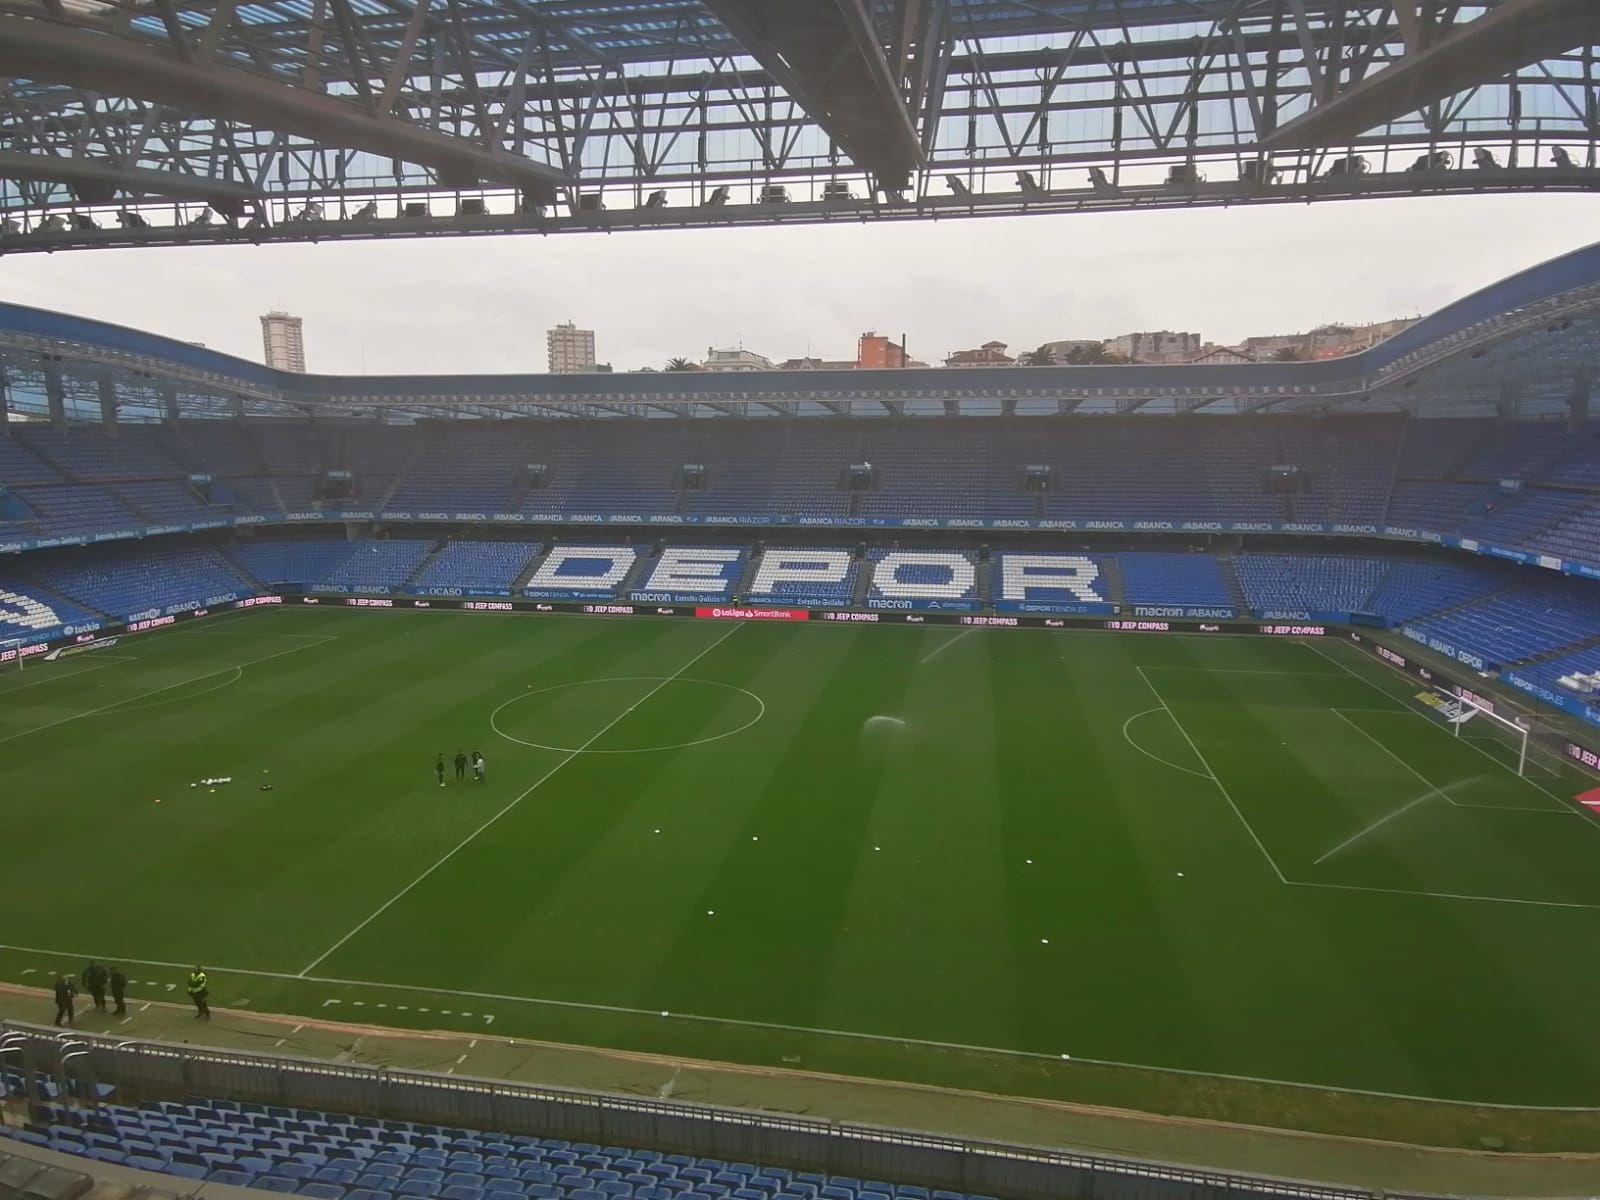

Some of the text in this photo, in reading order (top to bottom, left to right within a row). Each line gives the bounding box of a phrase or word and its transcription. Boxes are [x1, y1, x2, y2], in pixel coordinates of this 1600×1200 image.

[418, 512, 448, 520] ABANCA
[493, 513, 524, 521] ABANCA
[532, 514, 564, 522] ABANCA
[705, 516, 738, 524] ABANCA
[739, 516, 770, 524] RIAZOR
[834, 518, 866, 526] RIAZOR
[903, 518, 938, 526] ABANCA
[992, 520, 1030, 528] ABANCA
[1038, 520, 1077, 528] ABANCA
[1085, 520, 1124, 528] ABANCA
[1133, 522, 1173, 530] ABANCA
[1182, 522, 1223, 530] ABANCA
[1232, 522, 1273, 530] ABANCA
[1281, 523, 1323, 532] ABANCA
[1332, 524, 1377, 534] ABANCA
[353, 586, 390, 594] ABANCA
[429, 588, 462, 596] OCASO
[631, 592, 671, 602] macron
[166, 600, 202, 614] ABANCA
[868, 600, 912, 608] macron
[722, 608, 792, 618] LaLiga SmartBank
[1135, 606, 1233, 618] macron ABANCA
[836, 612, 850, 620] JEEP
[851, 612, 879, 622] COMPASS
[1263, 612, 1311, 621] ABANCA
[972, 616, 987, 625] JEEP
[988, 617, 1018, 626] COMPASS
[1121, 621, 1137, 630] JEEP
[1138, 622, 1170, 630] COMPASS
[1274, 626, 1291, 634] JEEP
[1581, 750, 1598, 766] JEEP
